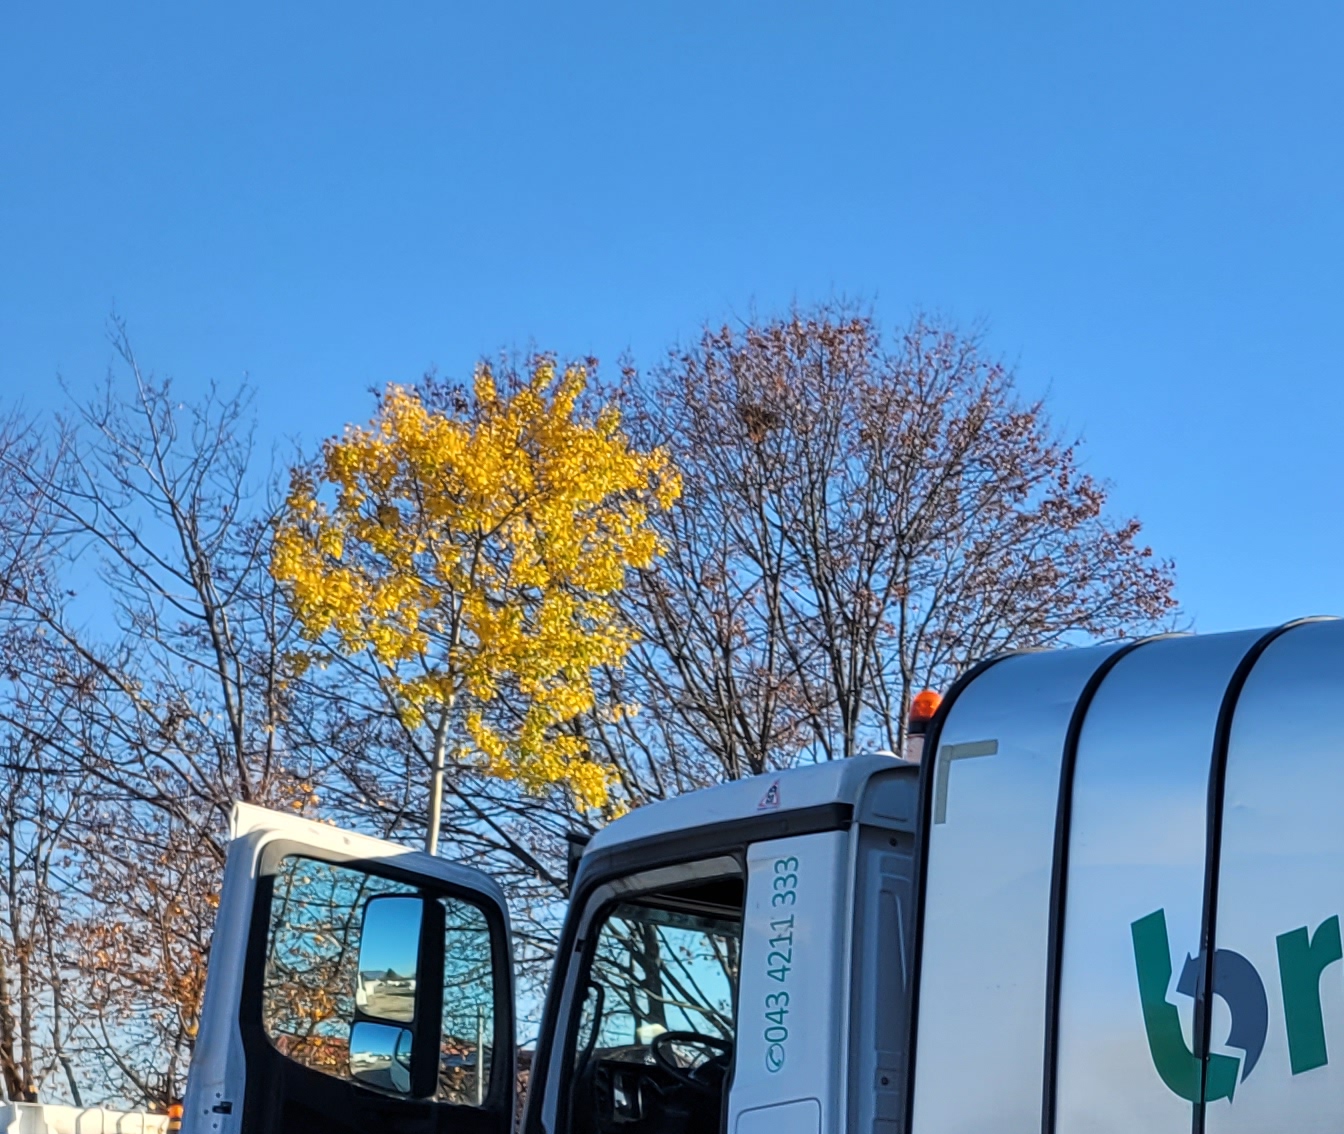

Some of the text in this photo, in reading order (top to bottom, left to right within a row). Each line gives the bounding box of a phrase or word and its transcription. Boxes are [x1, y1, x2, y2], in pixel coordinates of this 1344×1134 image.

[764, 856, 799, 1043] 043 4211 333
